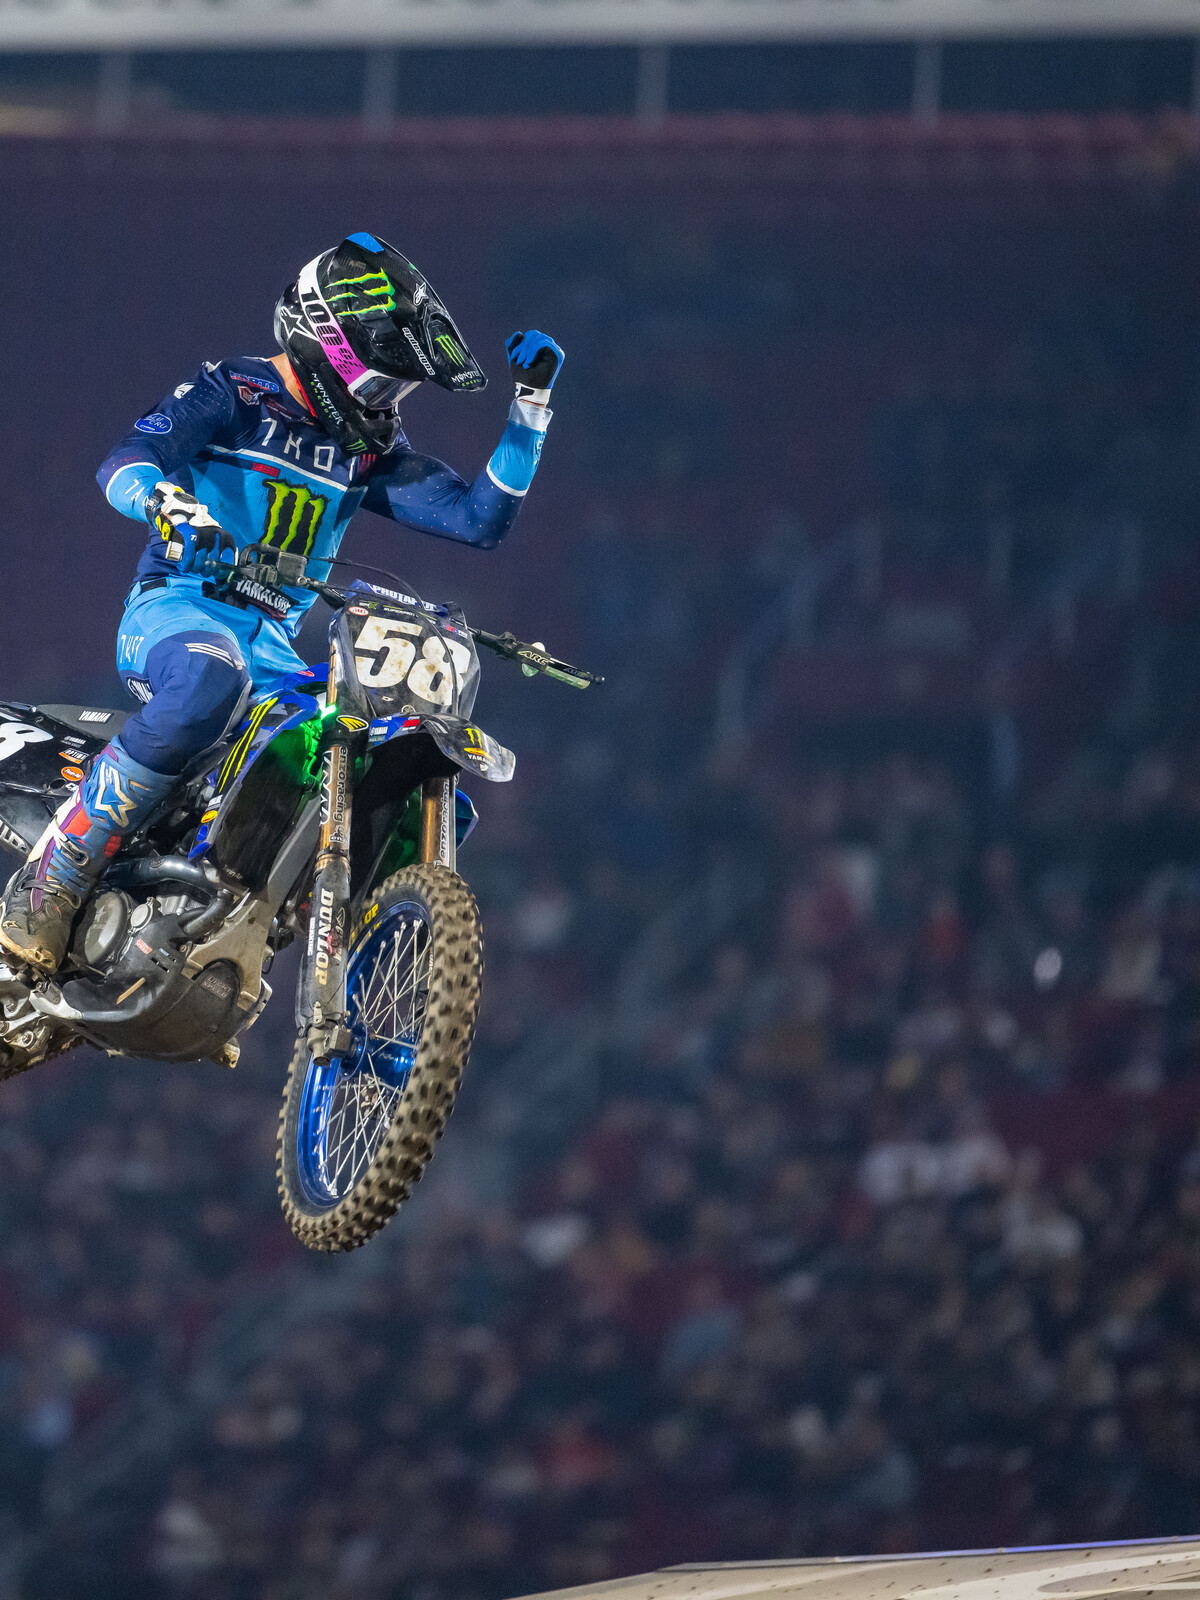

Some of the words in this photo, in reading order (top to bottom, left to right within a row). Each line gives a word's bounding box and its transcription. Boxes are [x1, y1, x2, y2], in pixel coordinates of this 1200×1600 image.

[300, 286, 364, 375] 100%
[311, 373, 344, 426] MONSTER
[354, 615, 472, 706] 58
[78, 710, 112, 723] YAMAHA
[315, 888, 334, 986] DUNLOP
